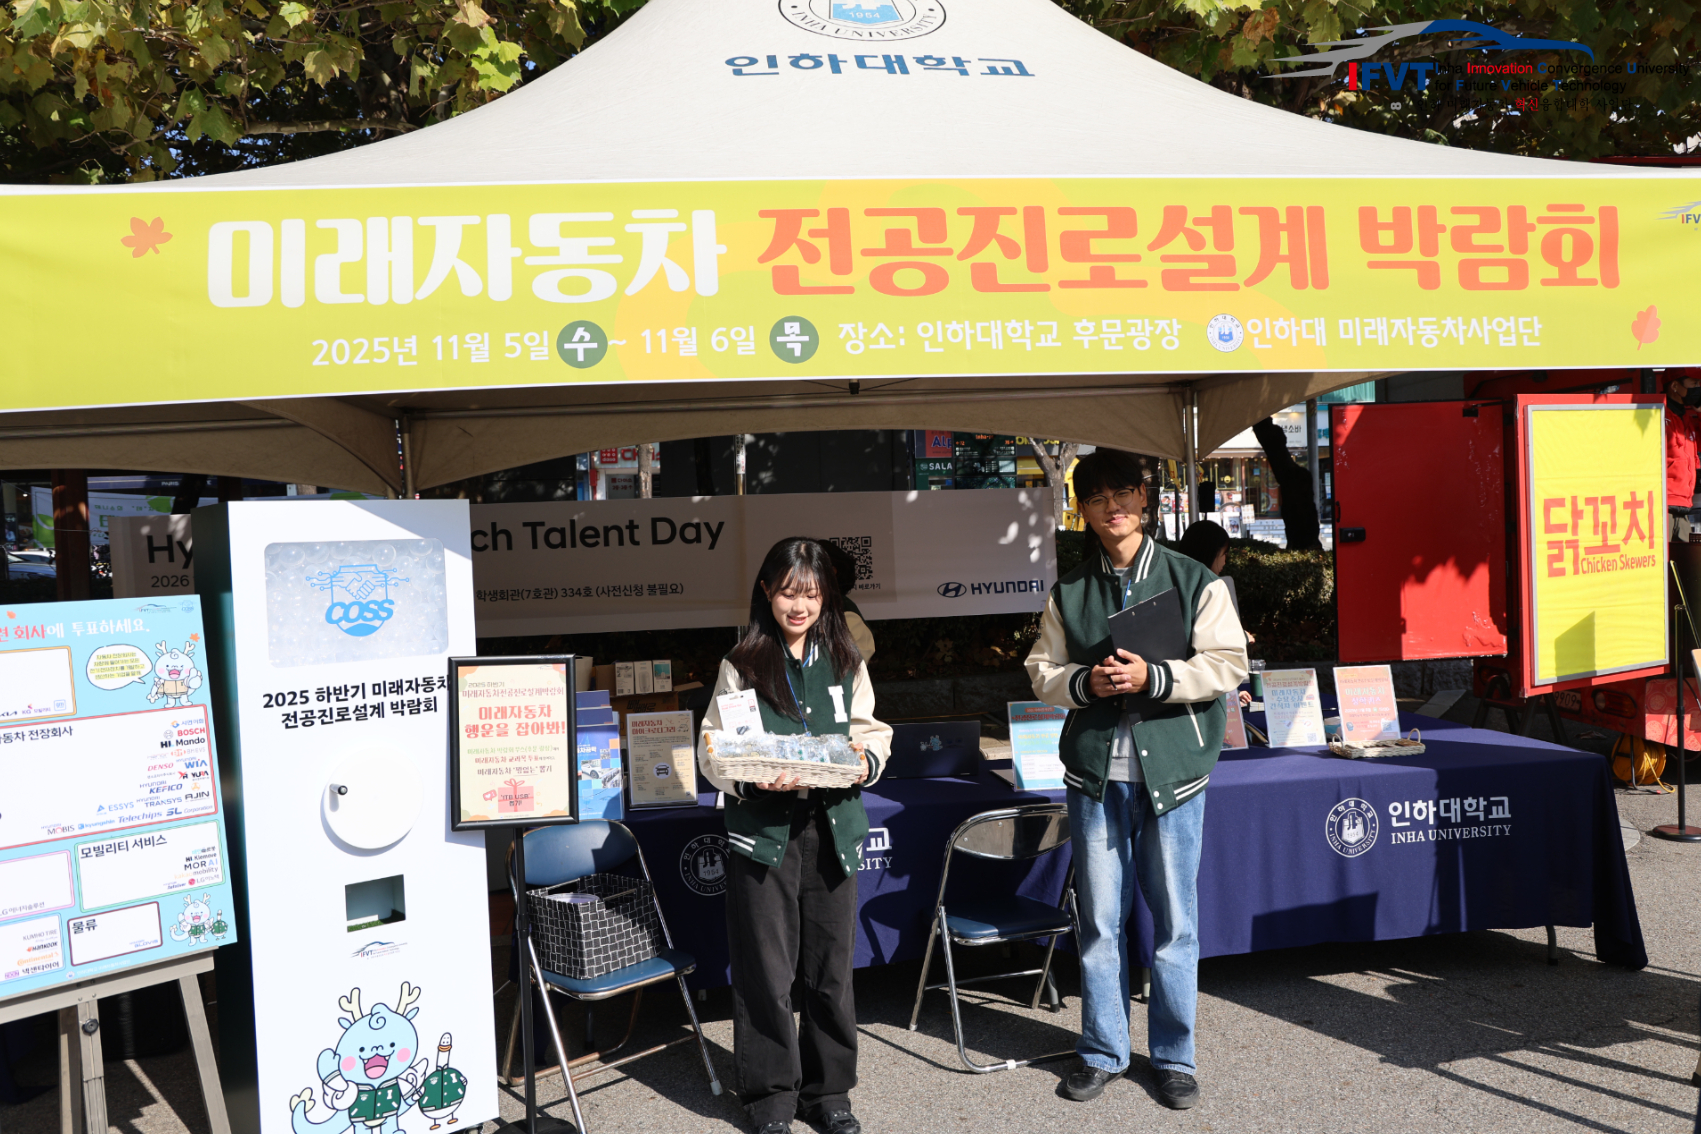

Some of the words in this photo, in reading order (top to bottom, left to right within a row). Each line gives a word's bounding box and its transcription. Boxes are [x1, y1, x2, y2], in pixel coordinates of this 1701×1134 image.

[848, 10, 881, 19] 1954
[791, 11, 827, 33] INHA
[834, 13, 938, 38] UNIVERSITY
[725, 53, 1035, 77] 인하대학교
[207, 208, 727, 309] 미래자동차
[757, 204, 1329, 297] 전공진로설계
[1358, 203, 1620, 291] 박람회
[311, 334, 418, 366] 2025년
[432, 332, 491, 363] 11월
[504, 330, 550, 360] 5일
[563, 326, 598, 362] 수
[641, 326, 698, 357] 11월
[711, 325, 756, 355] 6일
[776, 321, 810, 357] 목
[838, 321, 906, 355] 장소:
[916, 319, 1062, 353] 인하대학교
[1072, 318, 1183, 351] 후문광장
[1246, 316, 1327, 349] 인하대
[1338, 316, 1543, 348] 미래자동차사업단
[522, 518, 640, 550] Talent
[651, 516, 725, 550] Day
[1543, 490, 1655, 578] 닭꼬치
[1581, 556, 1618, 574] Chicken
[1619, 554, 1656, 571] Skewers
[151, 576, 190, 588] 2026
[971, 580, 1044, 595] HYUNDAI
[476, 588, 558, 602] 학생회관(7호관)
[561, 586, 594, 599] 334호
[596, 584, 644, 598] (사전신청
[646, 582, 684, 597] 불필요)
[325, 599, 395, 624] COSS
[13, 623, 64, 640] 회사에
[71, 618, 150, 637] 투표하세요.
[263, 690, 309, 708] 2025
[315, 683, 366, 703] 하반기
[372, 675, 449, 698] 미래자동차
[281, 701, 385, 730] 전공진로설계
[390, 696, 438, 717] 박람회
[478, 704, 552, 720] 미래자동차
[828, 685, 849, 723] I
[0, 730, 26, 744] 동차
[28, 725, 73, 741] 전장회사
[177, 727, 206, 737] BOSCH
[464, 722, 510, 739] 행운을
[515, 721, 566, 737] 잡아봐!
[175, 737, 206, 746] Mando
[147, 763, 174, 771] DENSO
[140, 780, 167, 788] HYUNDAI
[149, 783, 183, 794] KEFICO
[144, 797, 183, 807] TRANSYS
[185, 791, 210, 800] AJIN
[108, 801, 135, 811] ESSYS
[1389, 796, 1512, 827] 인하대학교
[117, 811, 163, 823] Telechips
[47, 825, 75, 835] MOBIS
[1391, 830, 1426, 844] INHA
[1428, 825, 1512, 841] UNIVERSITY
[80, 840, 129, 859] 모빌리티
[131, 834, 168, 850] 서비스
[1329, 833, 1342, 850] INHA
[1342, 829, 1376, 855] UNIVERSITY
[684, 872, 699, 890] INHA
[72, 918, 98, 934] 물류
